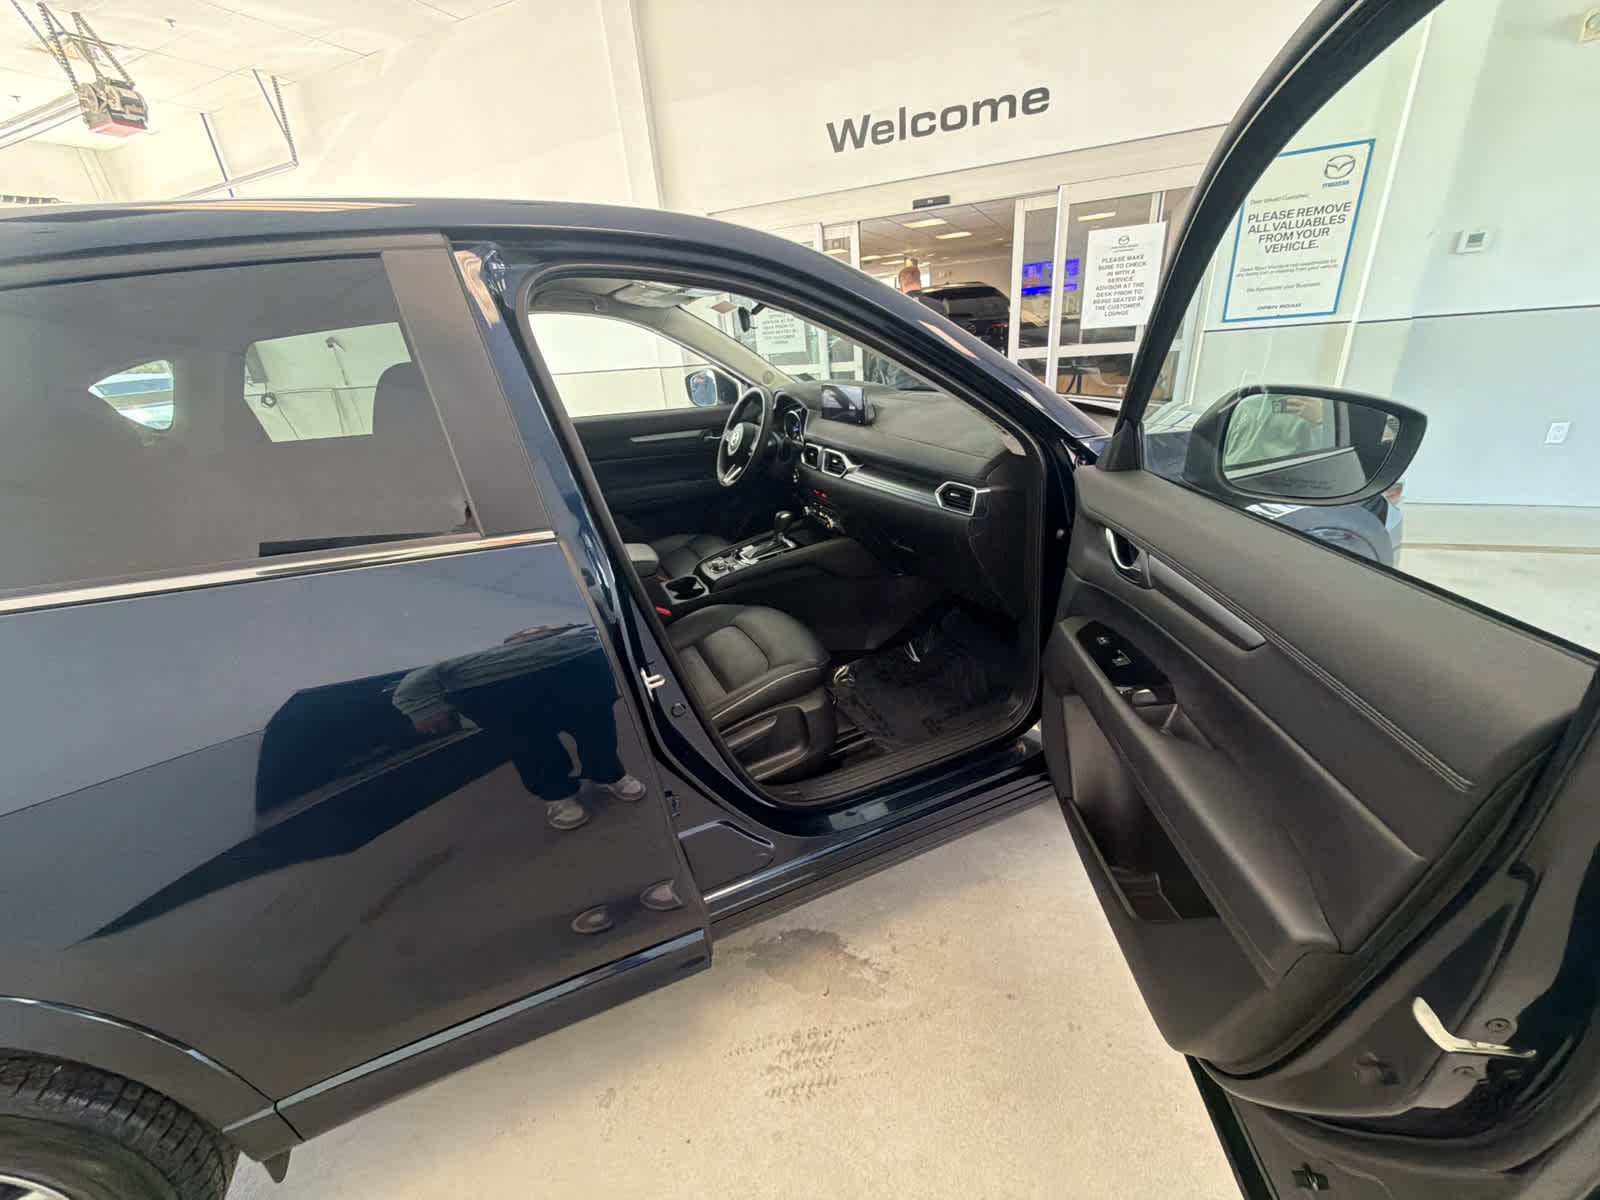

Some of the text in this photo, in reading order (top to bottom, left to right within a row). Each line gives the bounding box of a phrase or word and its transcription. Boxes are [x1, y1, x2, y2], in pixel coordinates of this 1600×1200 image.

[826, 86, 1050, 153] Welcome
[1248, 201, 1352, 223] PLEASE REMOVE
[1248, 214, 1346, 234] ALL VALUABLES
[1258, 227, 1330, 243] FROM YOUR
[1265, 239, 1319, 254] VEHICLE.
[1107, 302, 1141, 310] CUSTOMER
